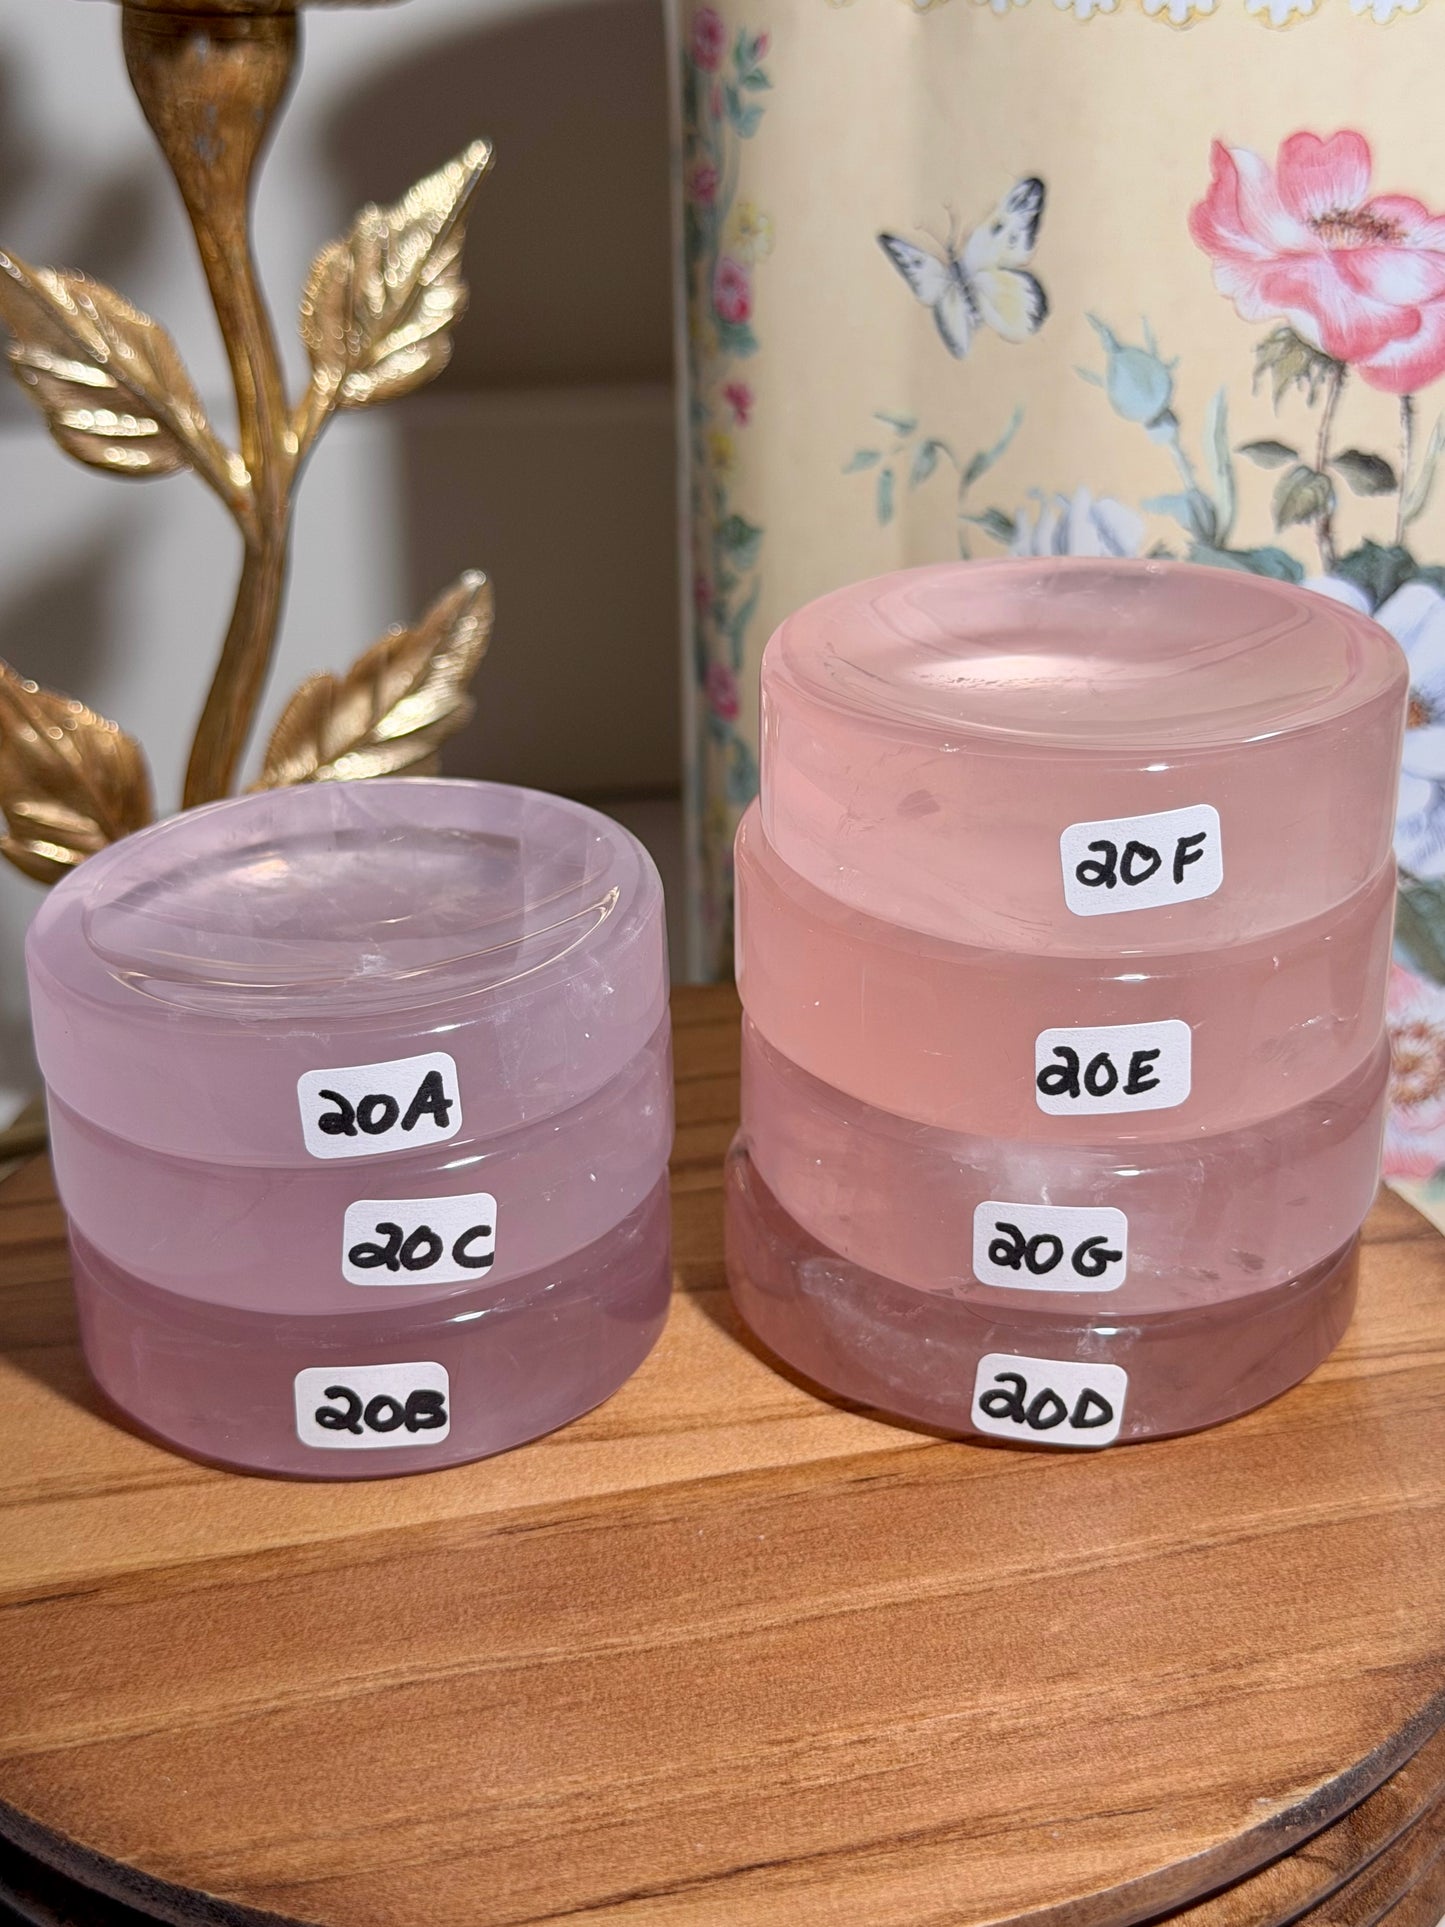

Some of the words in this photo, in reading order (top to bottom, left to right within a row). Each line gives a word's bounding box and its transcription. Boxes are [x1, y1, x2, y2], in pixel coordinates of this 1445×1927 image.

[1076, 832, 1207, 889] 20F
[1036, 1046, 1161, 1099] 20E
[318, 1070, 453, 1137] 20A
[348, 1222, 496, 1272] 20C
[988, 1222, 1123, 1277] 20G
[315, 1386, 447, 1435] 20B
[979, 1372, 1114, 1430] 20D
